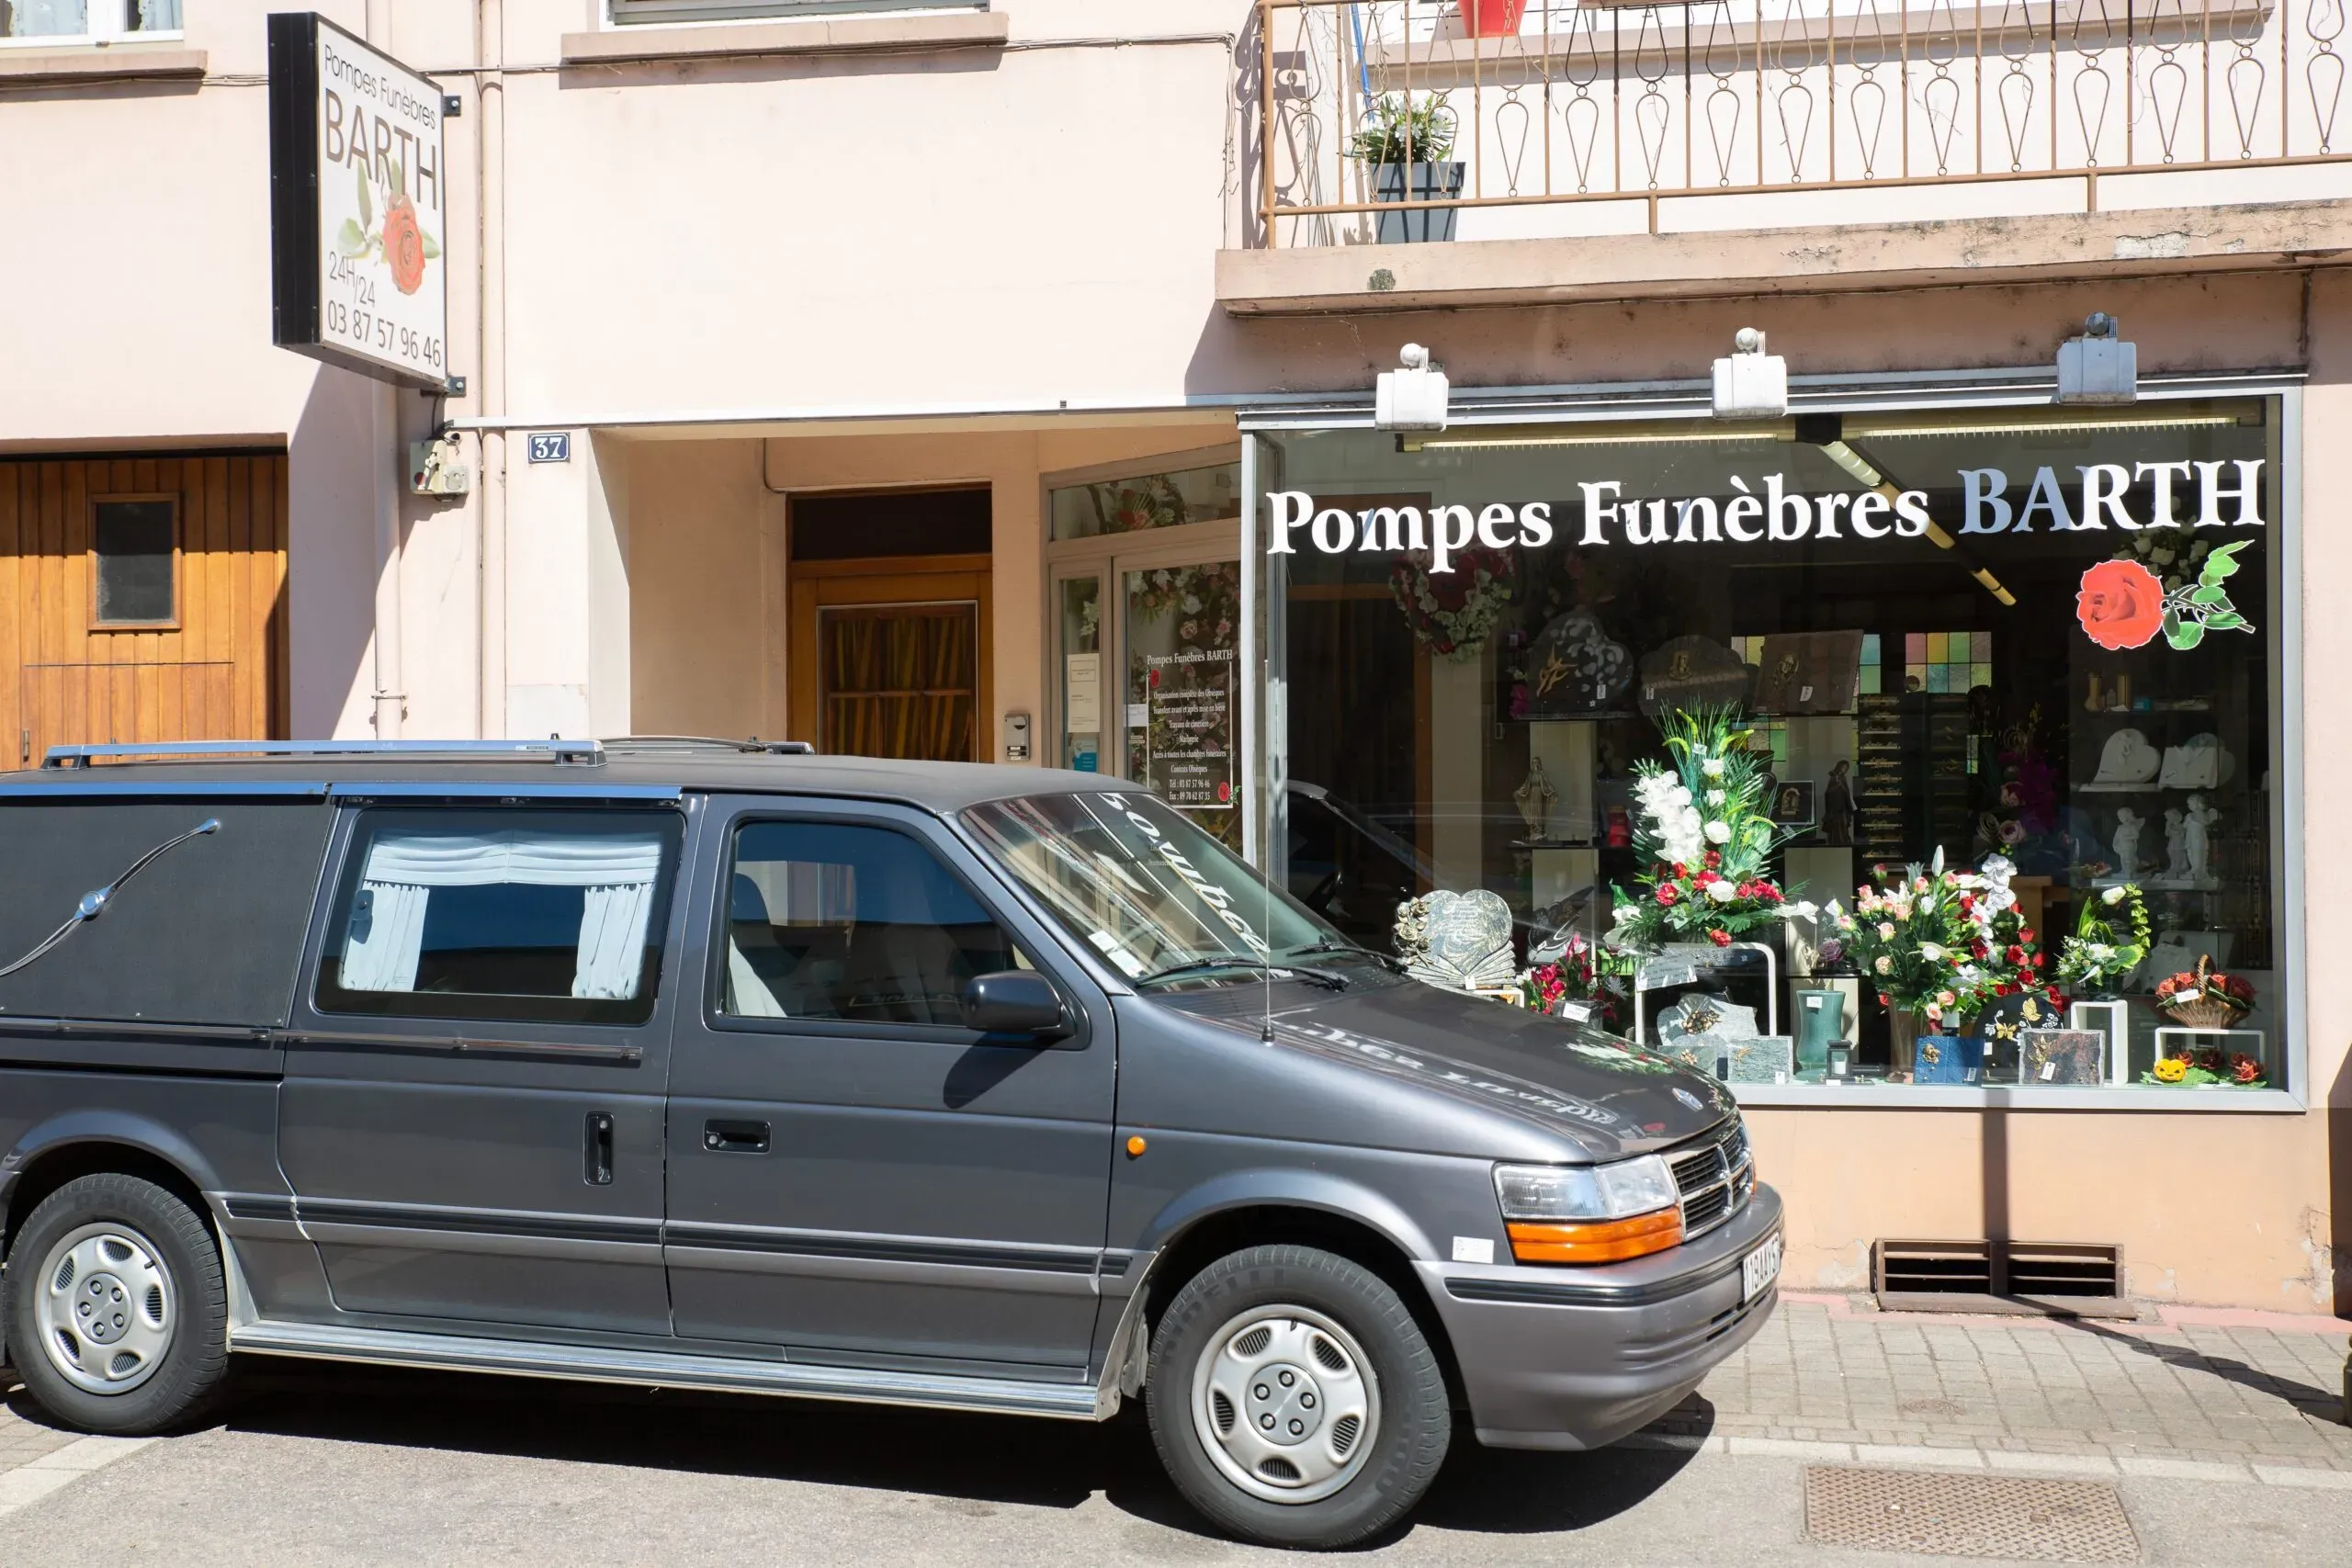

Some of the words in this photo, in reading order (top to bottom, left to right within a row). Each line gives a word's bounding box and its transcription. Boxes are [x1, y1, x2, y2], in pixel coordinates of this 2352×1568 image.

[325, 44, 377, 98] Pompes
[380, 77, 436, 130] Funèbres
[325, 87, 437, 210] BARTH
[328, 299, 346, 333] 03
[353, 310, 370, 342] 87
[378, 318, 394, 351] 57
[401, 327, 419, 359] 96
[424, 336, 441, 367] 46
[535, 436, 562, 458] 37
[1265, 491, 1554, 574] Pompes
[1577, 474, 1930, 547] Funèbres
[1957, 458, 2266, 535] BARTH
[1147, 654, 1173, 668] Pompes
[1174, 651, 1205, 663] Funèbres
[1206, 649, 1233, 661] BARTH
[1153, 690, 1180, 703] Organisation
[1179, 779, 1185, 788] 03
[1185, 779, 1192, 788] 87
[1192, 779, 1198, 788] 57
[1198, 779, 1204, 788] 96
[1204, 779, 1211, 788] 46
